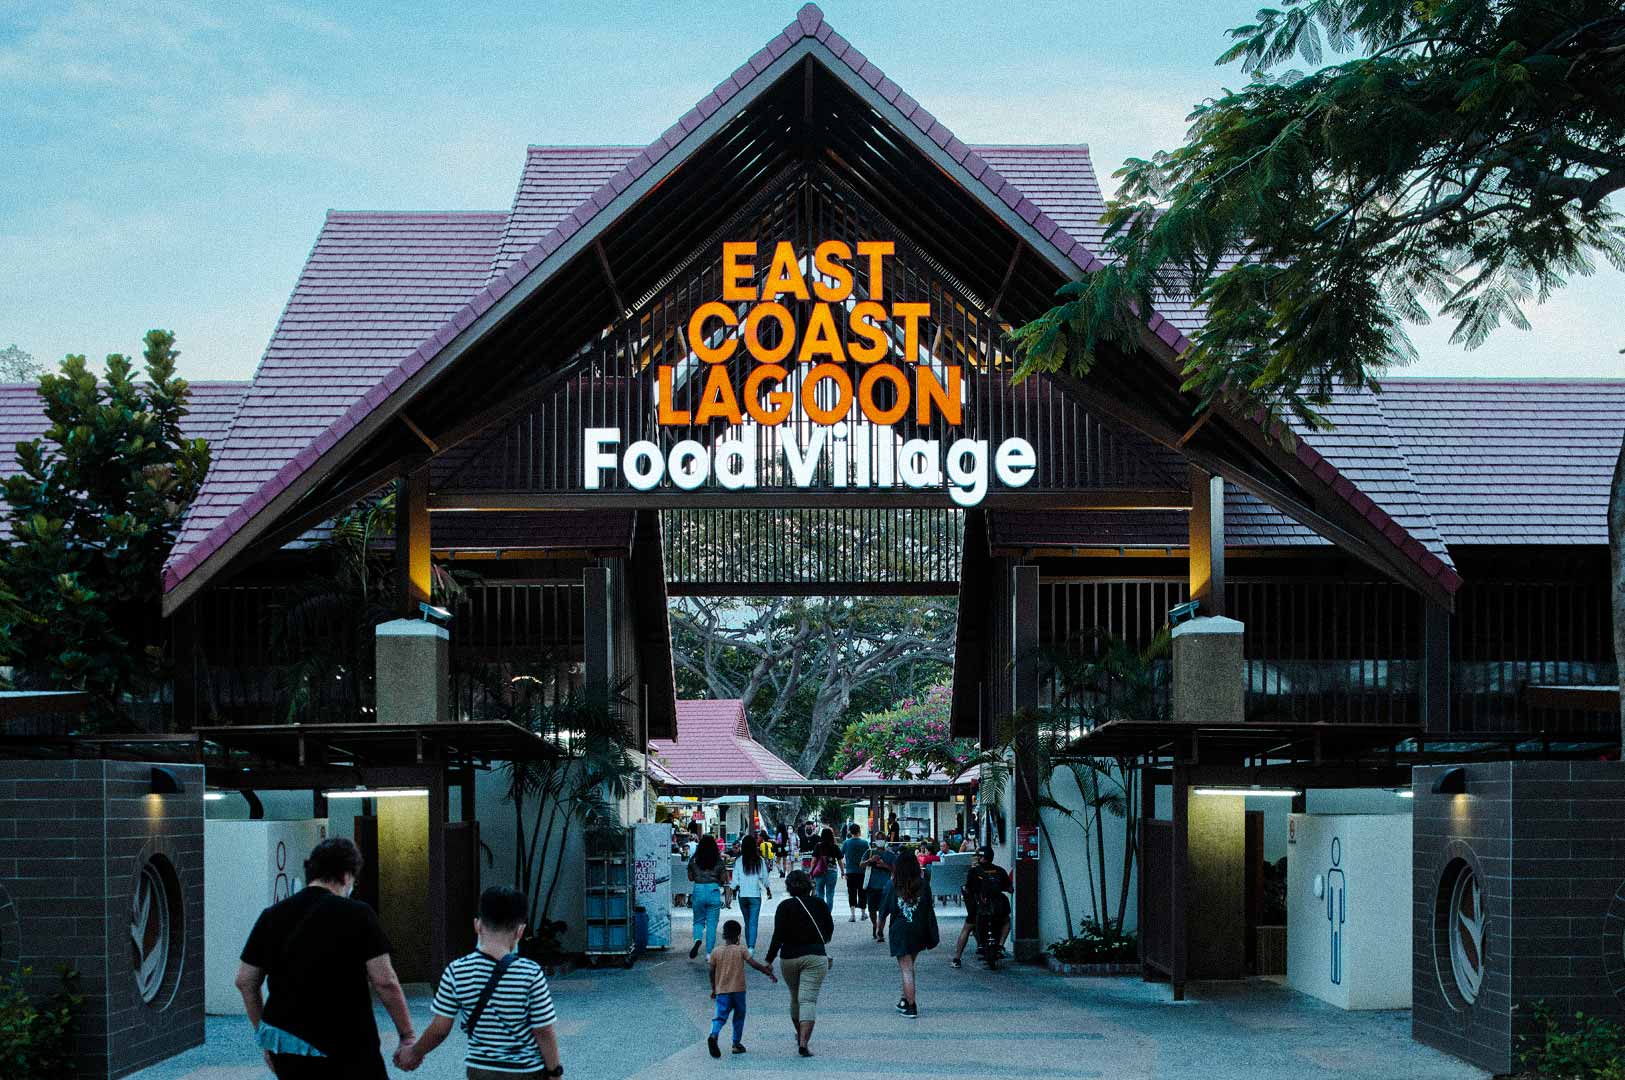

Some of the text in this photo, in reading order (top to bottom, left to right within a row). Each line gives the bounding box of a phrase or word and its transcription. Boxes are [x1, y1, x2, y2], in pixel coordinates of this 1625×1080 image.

[723, 241, 895, 301] EAST
[688, 302, 931, 363] COAST
[658, 364, 962, 426] LAGOON
[584, 423, 1037, 507] Food Village
